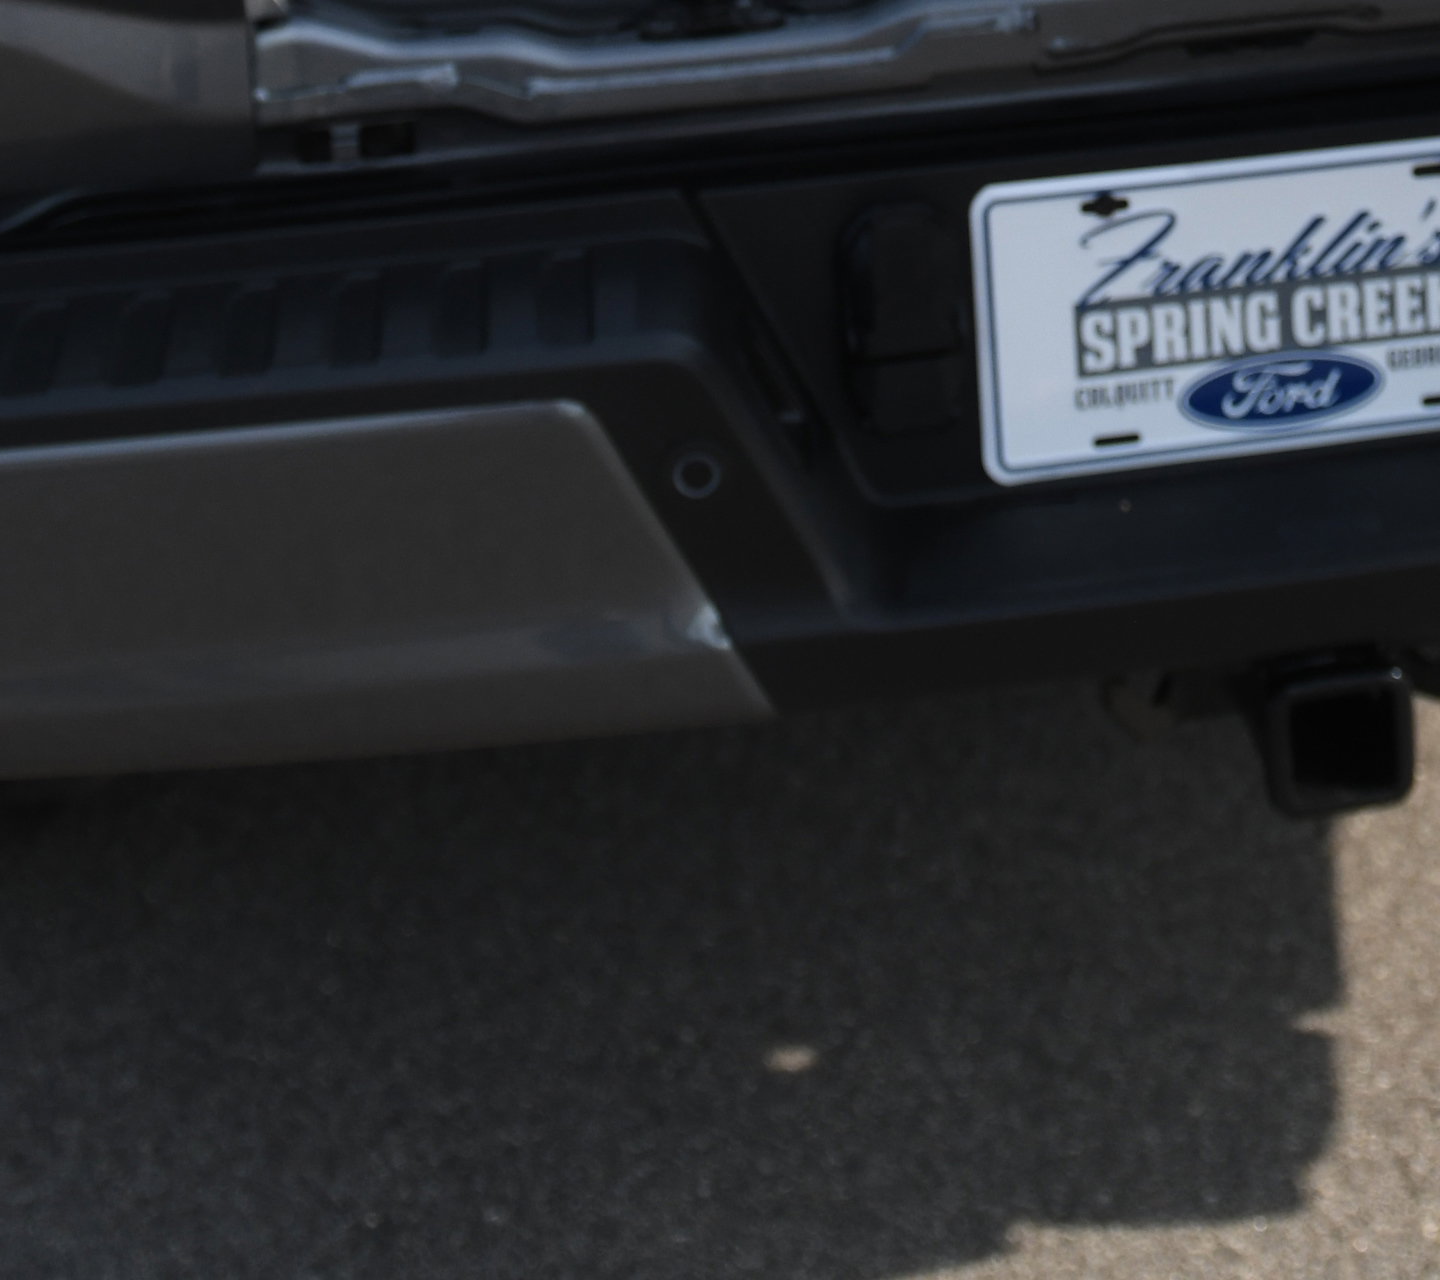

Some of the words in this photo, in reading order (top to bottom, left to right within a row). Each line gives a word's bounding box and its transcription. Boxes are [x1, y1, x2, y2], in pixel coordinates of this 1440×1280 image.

[1080, 290, 1282, 377] SPRING
[1074, 377, 1175, 410] COLQUITT
[1222, 361, 1342, 419] Ford
